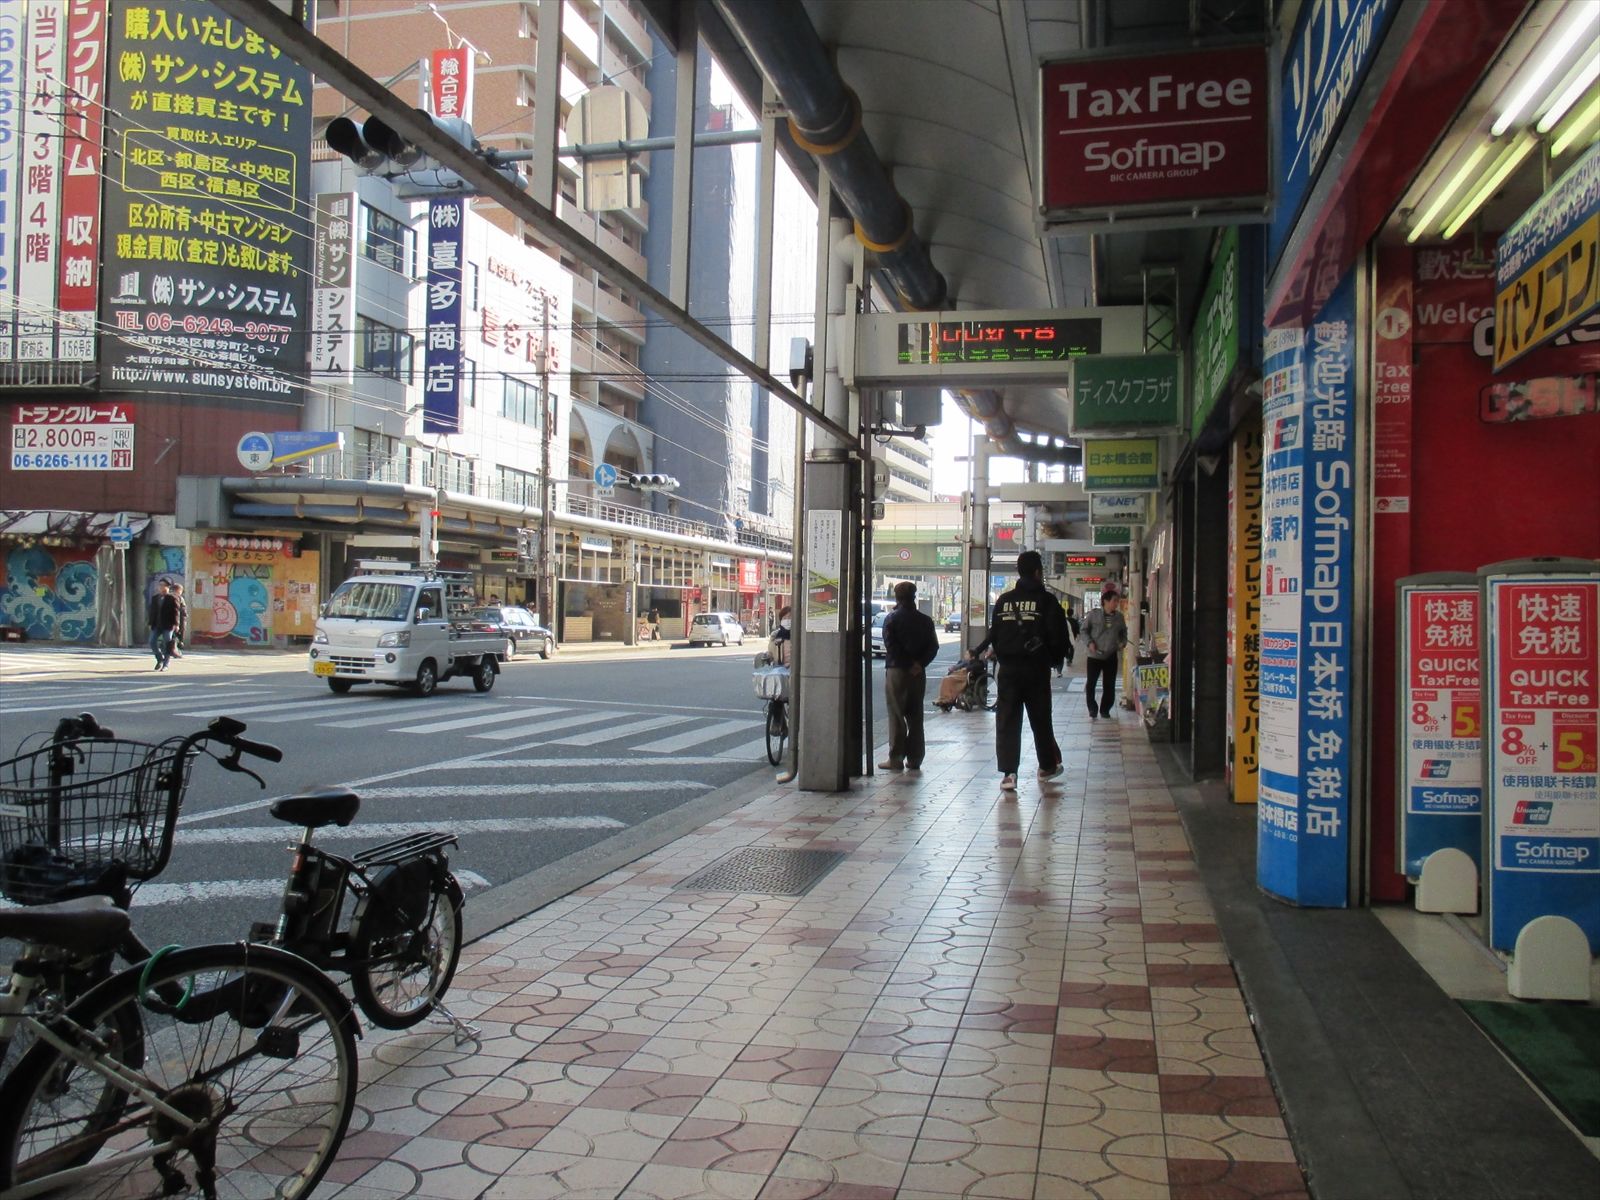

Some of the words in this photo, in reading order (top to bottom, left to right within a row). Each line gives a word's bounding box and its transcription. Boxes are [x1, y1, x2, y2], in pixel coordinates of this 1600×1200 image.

[440, 58, 459, 119] 総合家
[166, 127, 258, 150] 買取仕入エリア
[1083, 138, 1226, 172] Sofmap
[130, 149, 291, 185] 北区・都島区・中央区
[1110, 172, 1124, 182] BIC
[1126, 169, 1165, 181] CAMERA
[1167, 168, 1199, 178] GROUP
[161, 172, 260, 199] 西区・福島区
[129, 204, 293, 243] 区分所有・中古マンション
[65, 215, 95, 288] 収納
[116, 311, 143, 330] TEL
[146, 313, 292, 344] 06-6243-3077
[1376, 362, 1410, 378] Tax
[1078, 376, 1173, 406] ディスクプラザ
[1376, 381, 1410, 393] Free
[19, 405, 128, 423] トランクルーム
[114, 430, 130, 439] TRU
[14, 453, 108, 469] 06-6266-1112
[1305, 461, 1349, 613] Sofmap
[1425, 599, 1473, 622] 快速
[1518, 593, 1581, 623] 快速
[1425, 624, 1473, 647] 免税
[1518, 625, 1581, 655] 免税
[1418, 658, 1479, 672] QUICK
[1510, 669, 1590, 687] QUICK
[1517, 756, 1537, 765] OFF
[1306, 729, 1342, 838] 免税店
[1423, 791, 1479, 806] Sofmap
[1515, 842, 1590, 863] Sofmap
